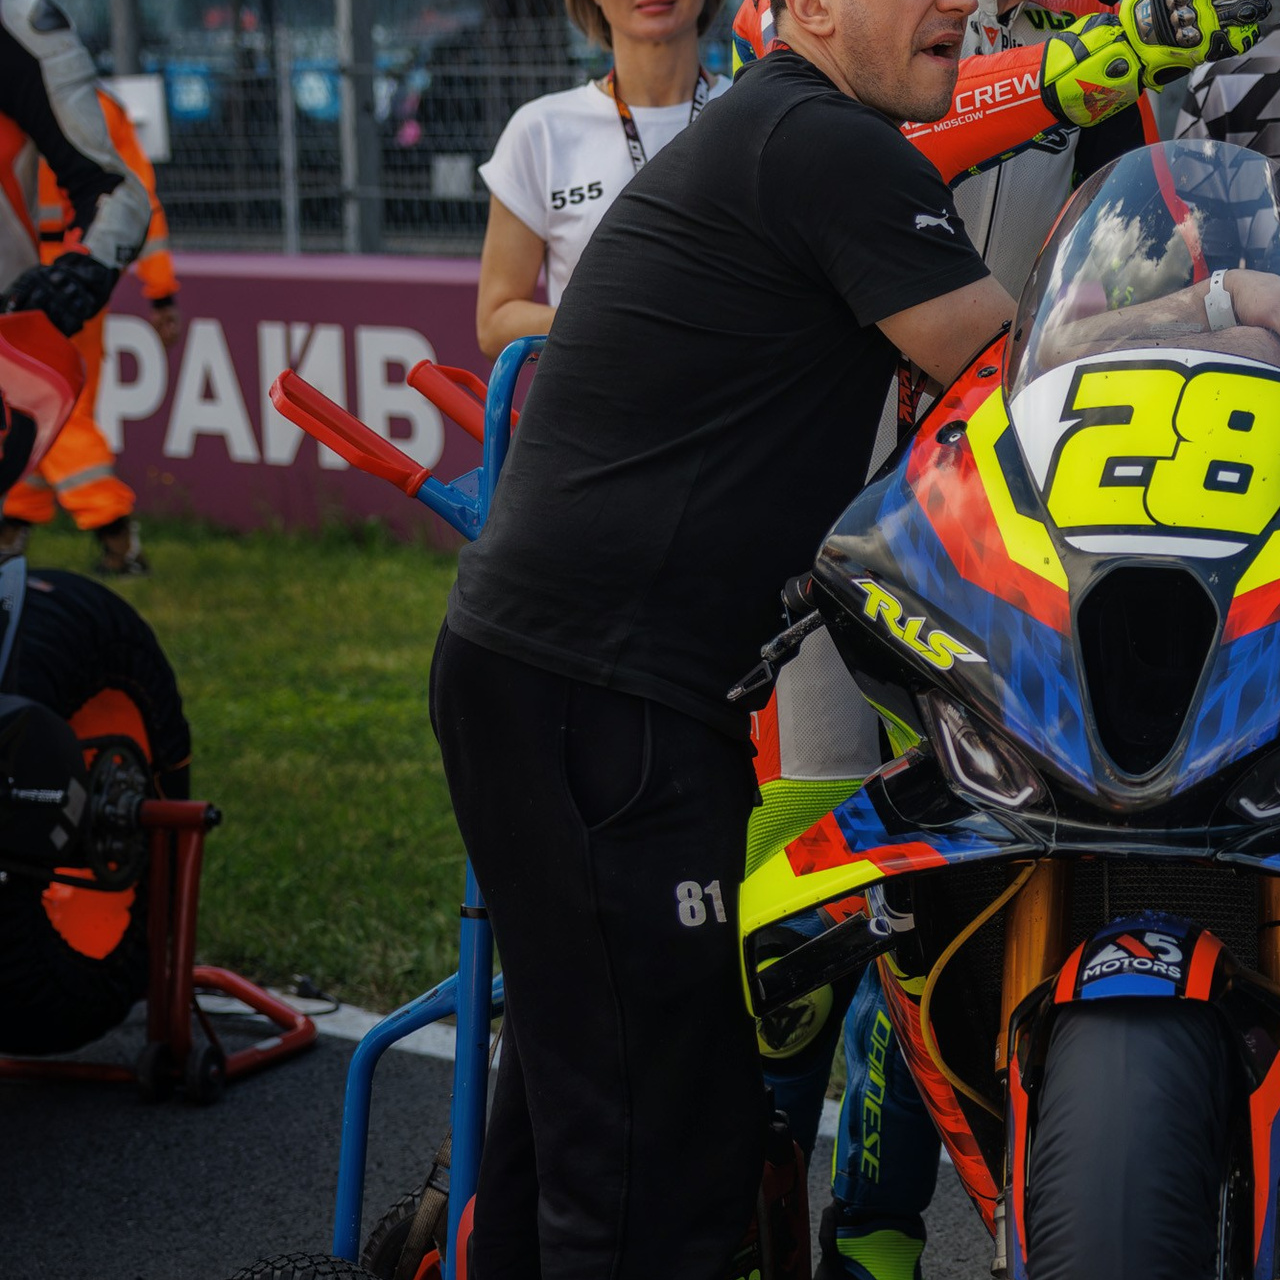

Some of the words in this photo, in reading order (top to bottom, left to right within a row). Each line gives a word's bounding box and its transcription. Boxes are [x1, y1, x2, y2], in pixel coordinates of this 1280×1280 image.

[956, 69, 1041, 114] CREW
[933, 110, 983, 132] MOSCOW
[551, 181, 604, 209] 555
[851, 578, 987, 670] RLS
[676, 879, 727, 928] 81
[1082, 957, 1182, 981] MOTORS
[860, 1010, 892, 1184] DAINESE
